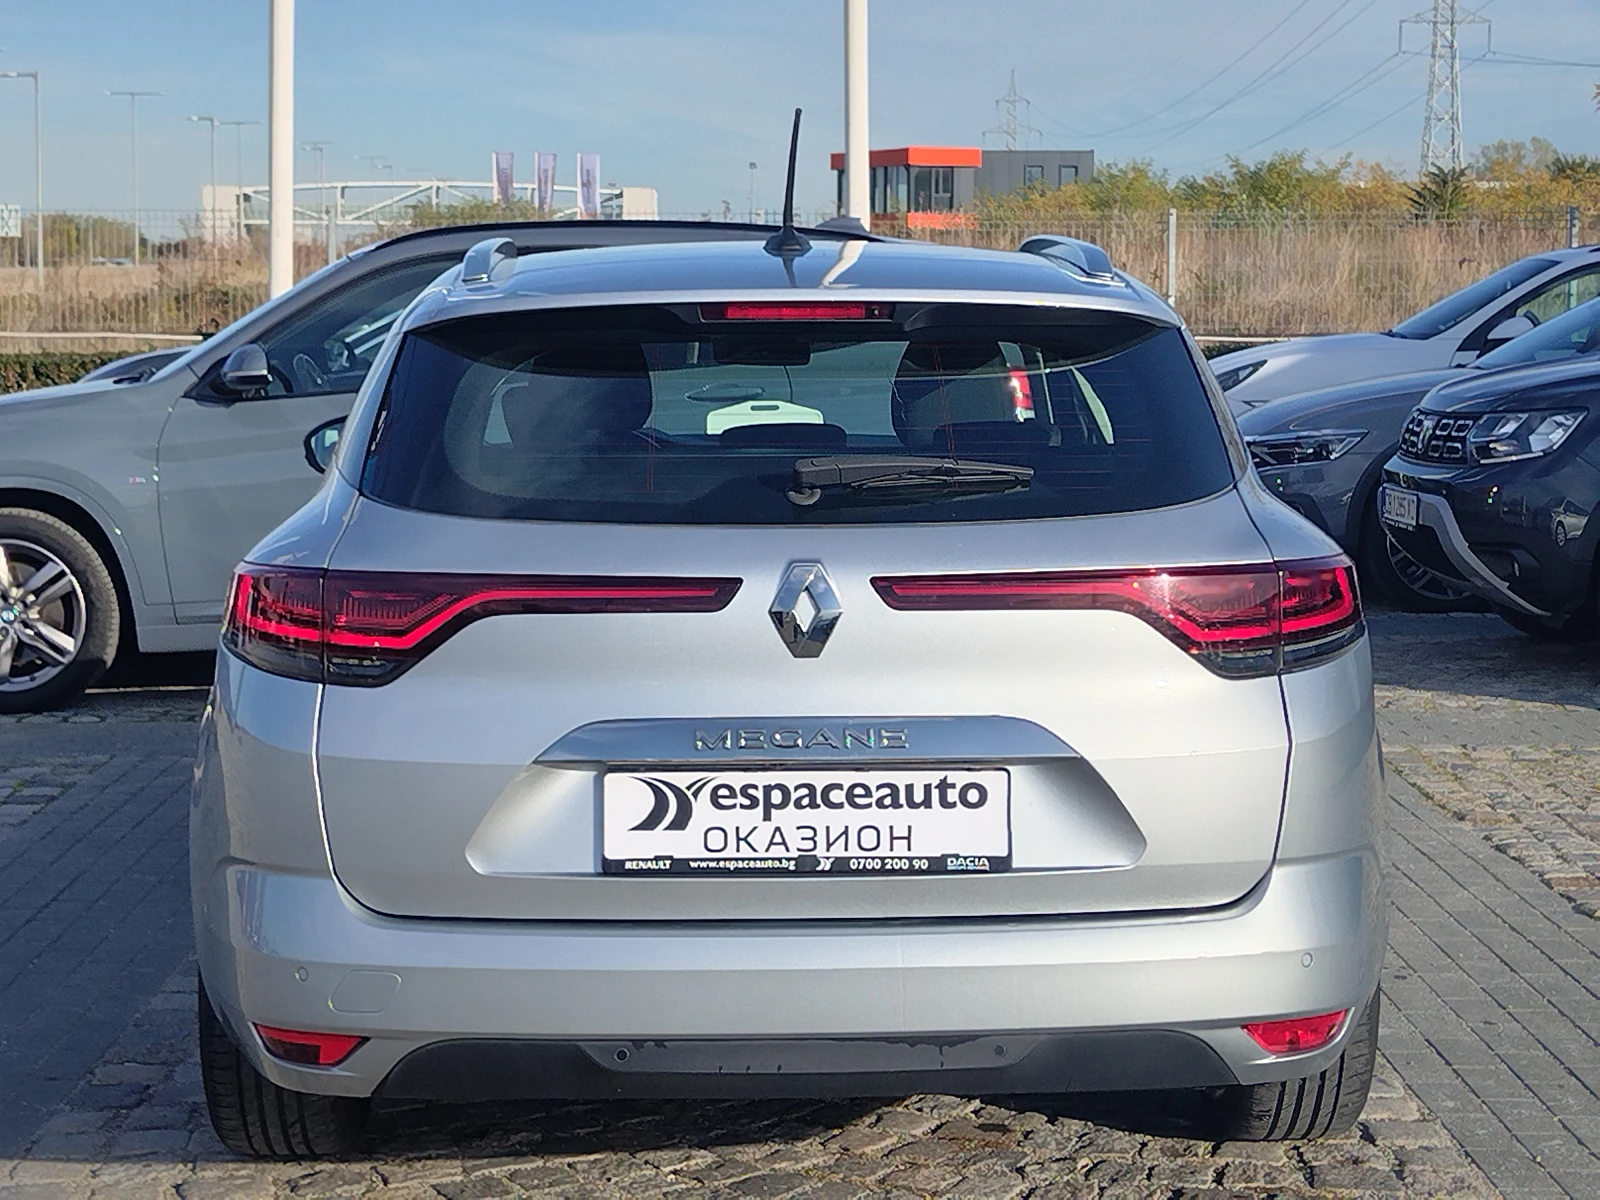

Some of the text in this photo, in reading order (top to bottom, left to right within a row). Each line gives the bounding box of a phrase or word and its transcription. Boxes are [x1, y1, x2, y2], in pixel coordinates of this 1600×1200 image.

[695, 727, 910, 750] MEGANE
[709, 775, 988, 822] espaceauto
[703, 825, 912, 853] ОКАЗИОН
[624, 860, 672, 870] RENAULT
[688, 858, 797, 872] www.espaceauto.bg
[849, 858, 929, 870] 0700 200 90
[946, 857, 990, 867] DACIA
